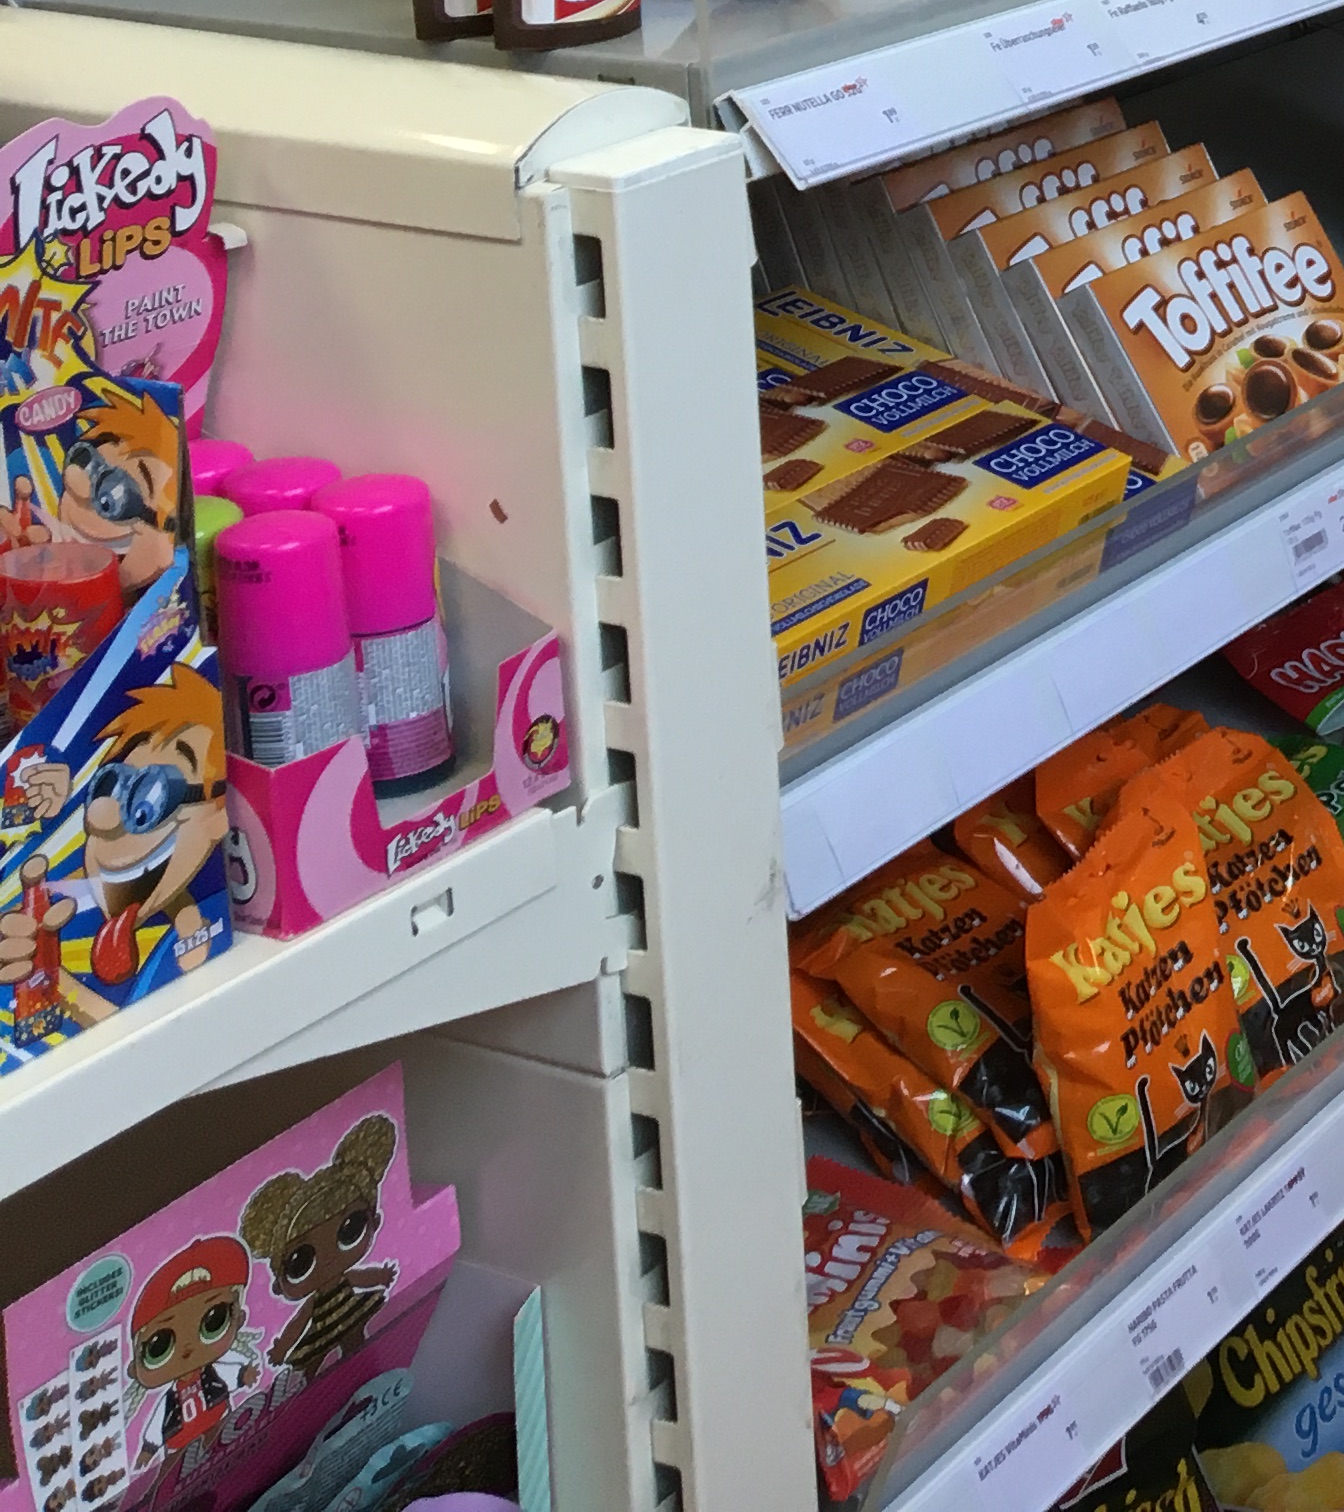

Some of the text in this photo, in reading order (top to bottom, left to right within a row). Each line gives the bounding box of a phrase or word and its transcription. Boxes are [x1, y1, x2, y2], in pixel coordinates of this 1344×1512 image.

[100, 299, 201, 348] THE TOWN
[124, 284, 186, 318] PAINT
[759, 291, 918, 359] LEIBNIZ
[1120, 240, 1338, 373] Toffifee
[18, 389, 77, 427] CANDY
[849, 374, 939, 422] CHOCO
[870, 383, 956, 430] VOLLMILCH
[989, 427, 1076, 474] CHOCO
[1010, 438, 1096, 484] VOLLMILCH
[862, 586, 924, 632] CHOCO
[1209, 828, 1294, 892] Katzen
[172, 938, 187, 957] 15
[895, 907, 988, 960] Katzen
[1050, 857, 1208, 1006] Katjes
[1116, 938, 1195, 1019] Katzen
[1120, 959, 1225, 1069] Pfötchen
